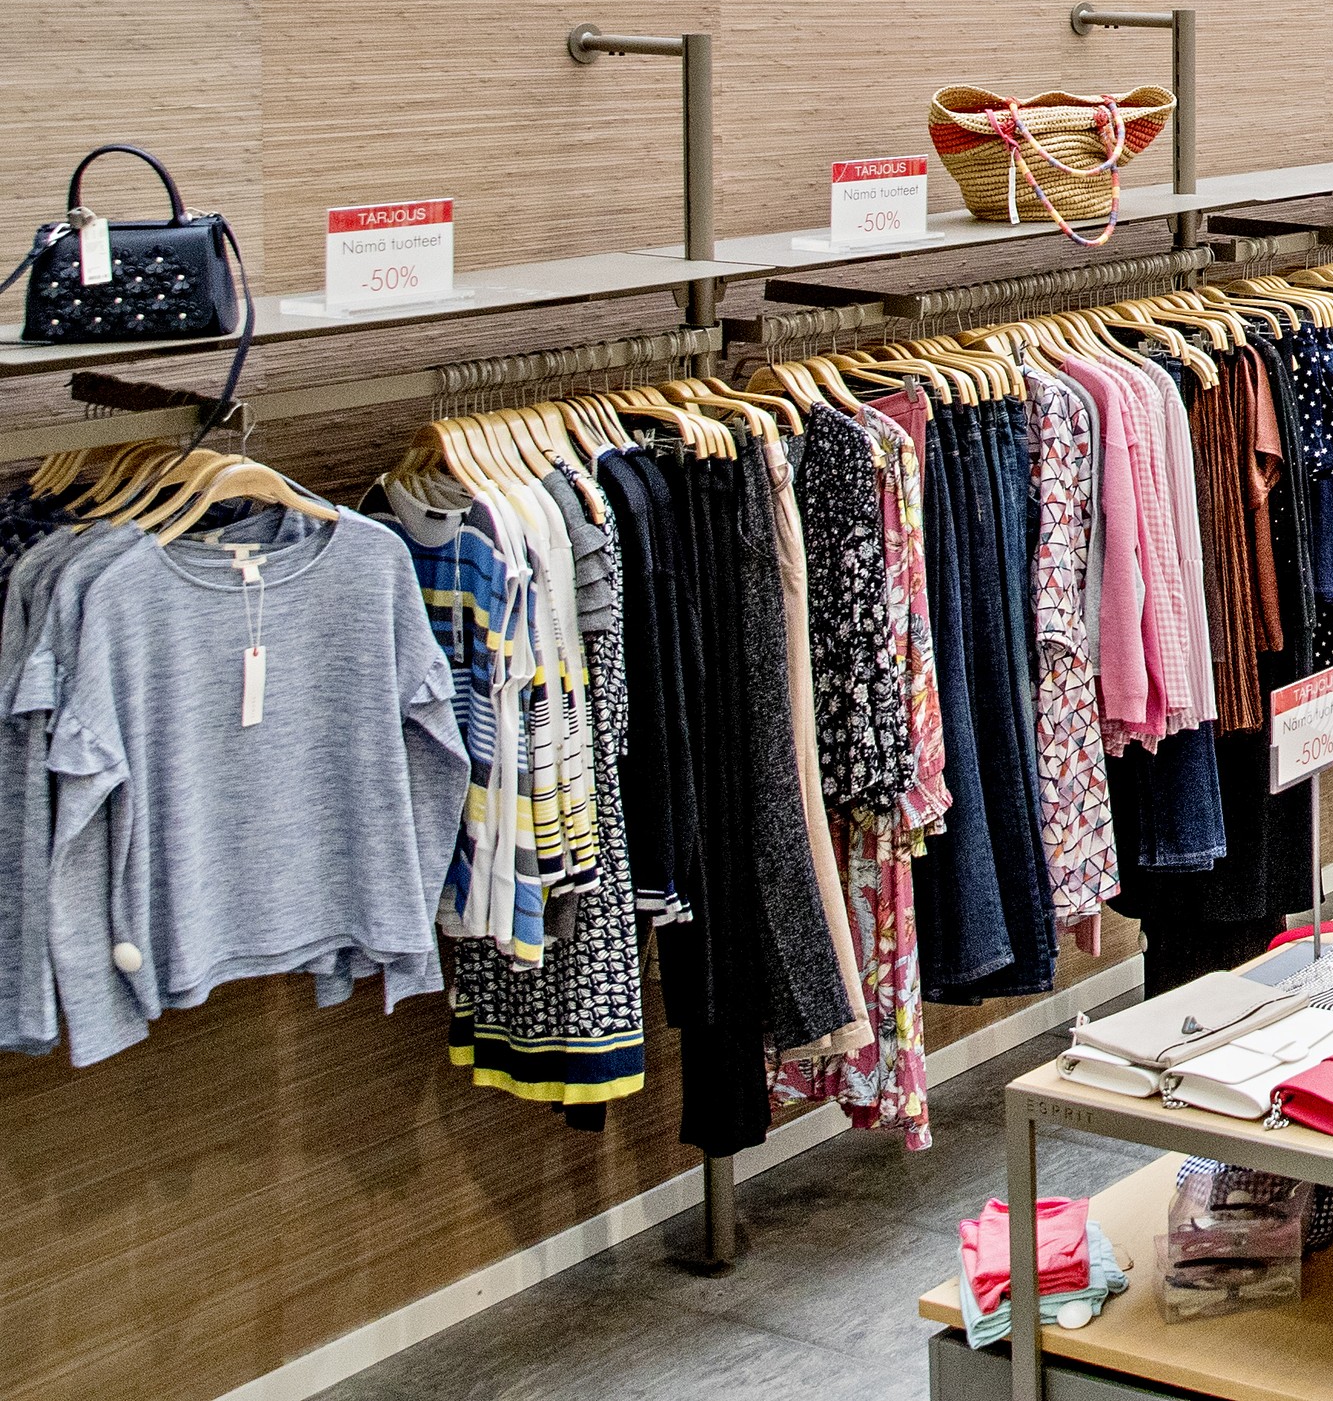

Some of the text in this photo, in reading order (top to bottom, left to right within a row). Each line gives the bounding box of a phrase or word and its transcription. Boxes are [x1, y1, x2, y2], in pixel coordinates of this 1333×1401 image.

[855, 162, 907, 177] TARJOUS
[843, 185, 919, 201] Nämä tuotteet
[358, 207, 426, 226] TARJOUS
[857, 210, 901, 232] -50%
[342, 233, 442, 255] Nämä tuotteet
[361, 265, 419, 292] -50%
